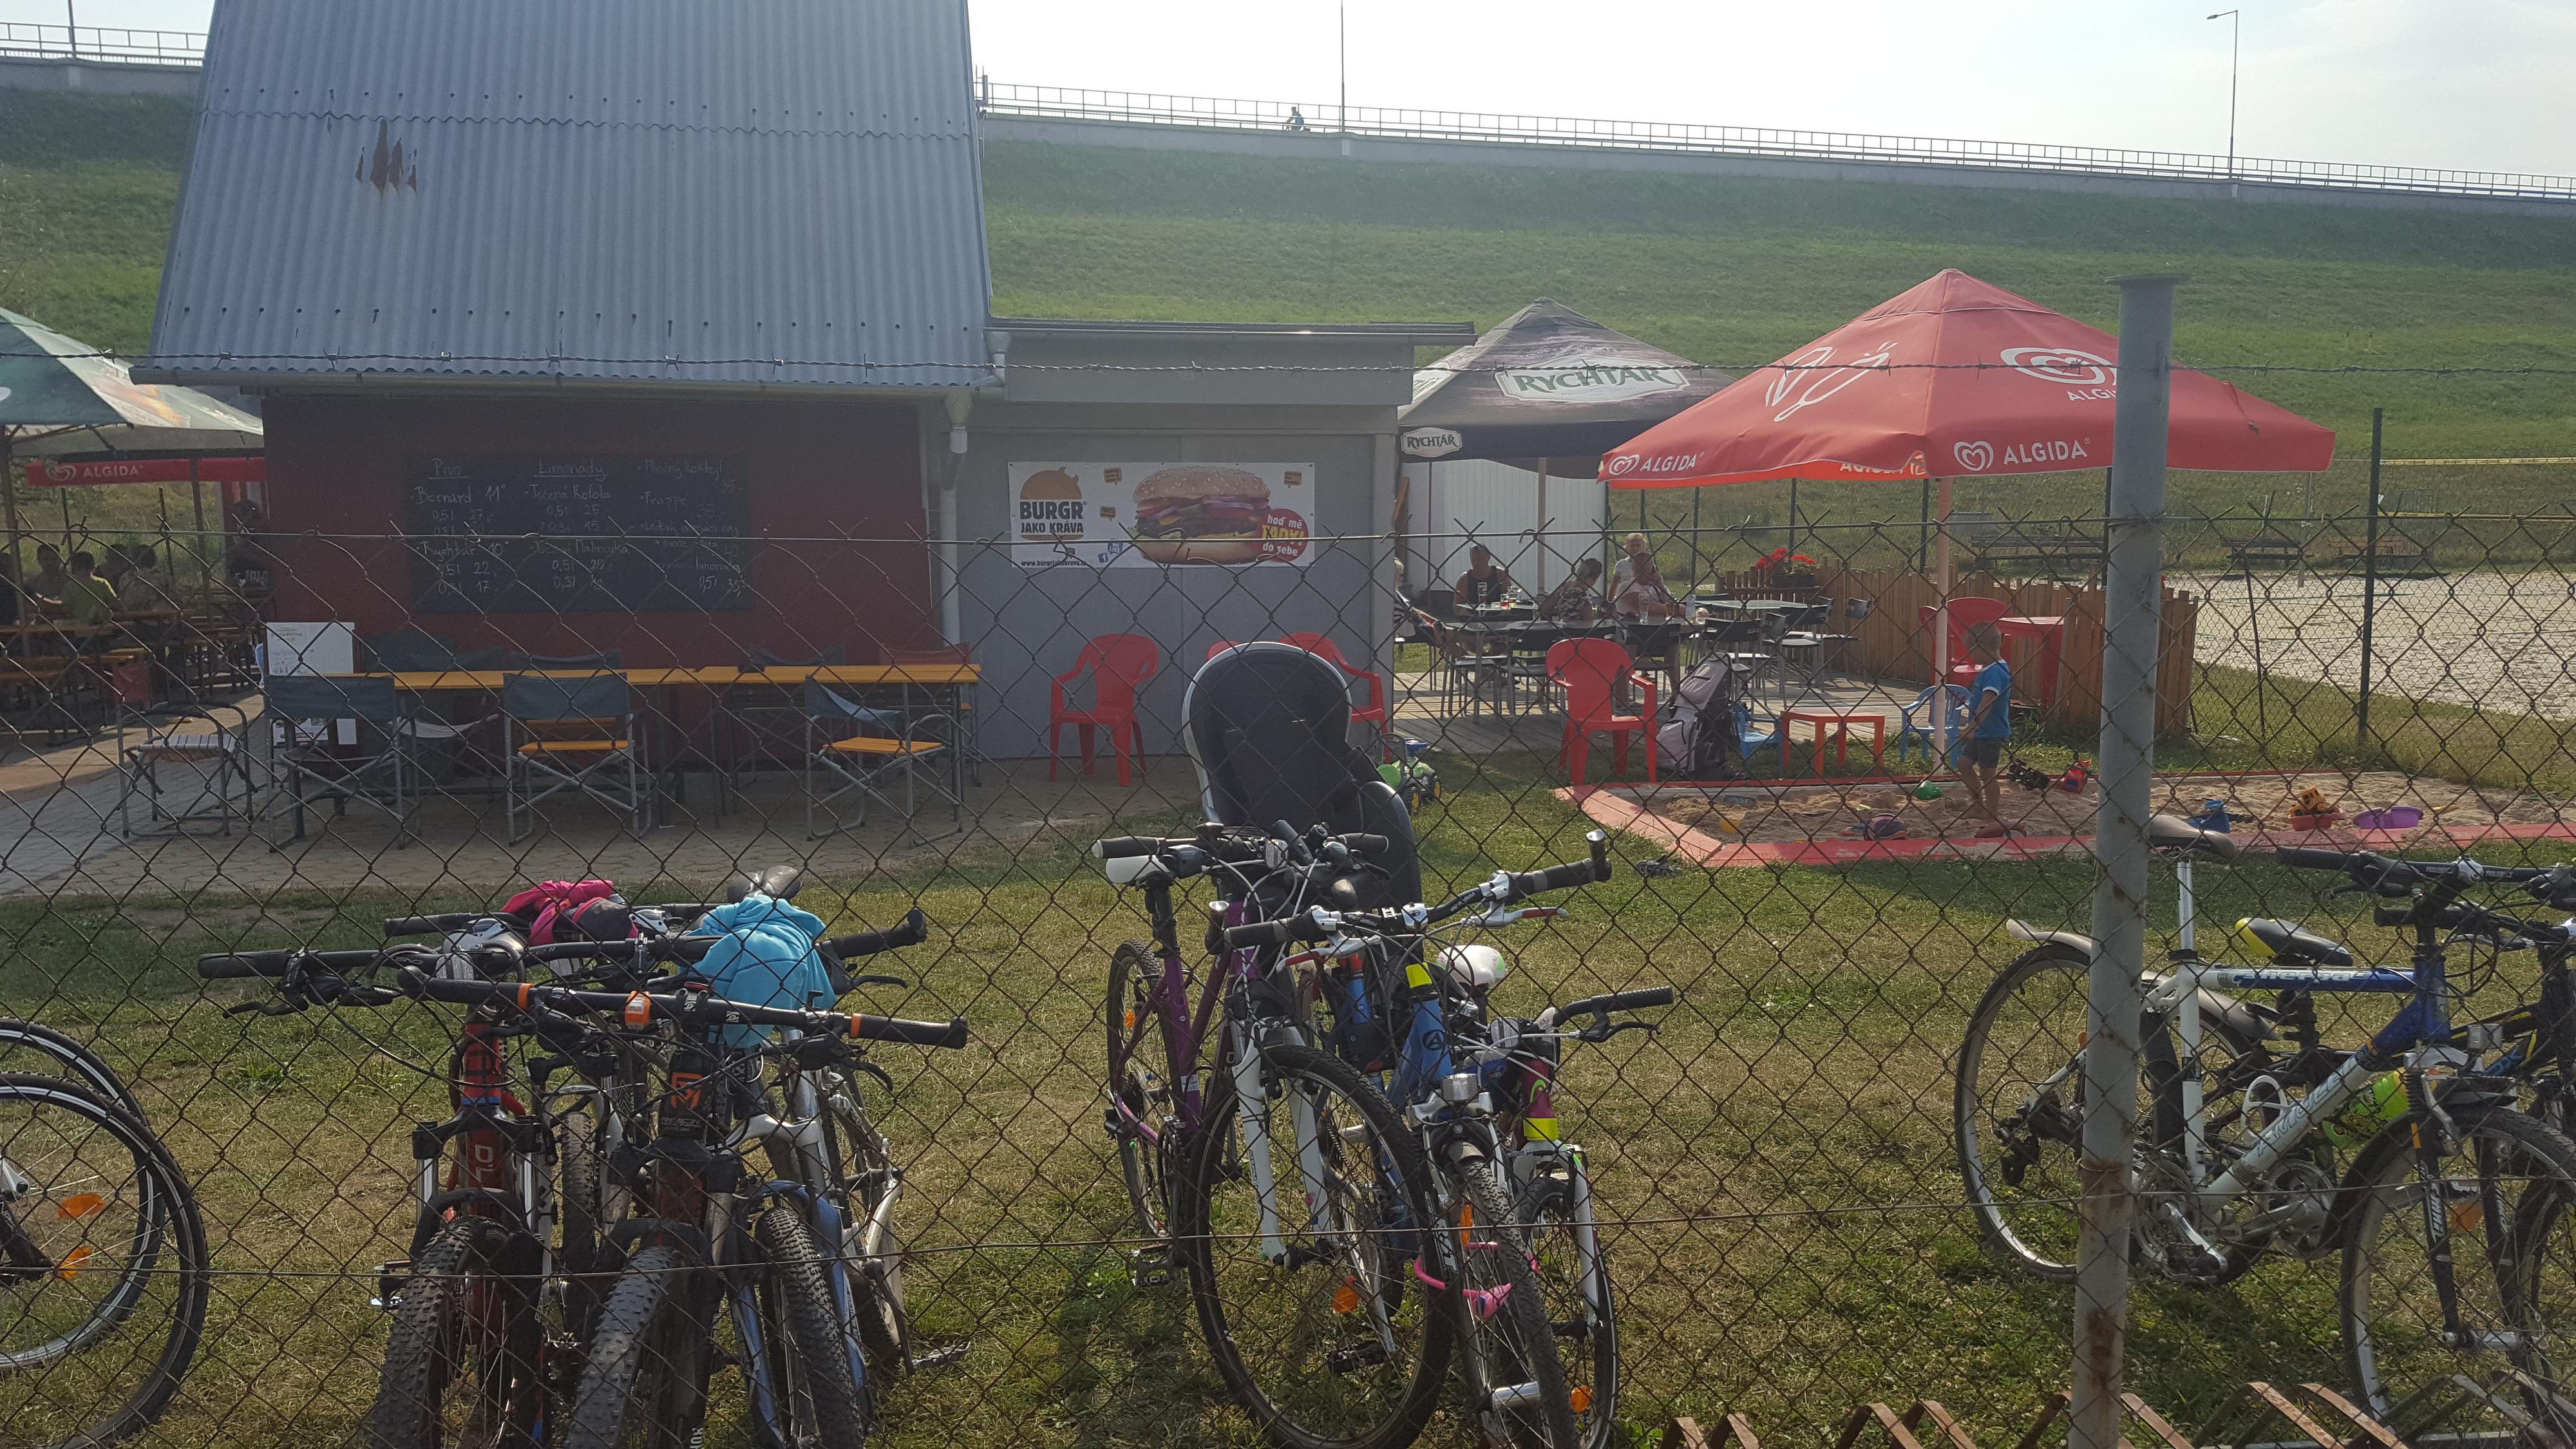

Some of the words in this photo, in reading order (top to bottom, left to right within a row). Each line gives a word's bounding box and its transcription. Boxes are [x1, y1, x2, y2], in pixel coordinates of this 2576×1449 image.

[2067, 388, 2116, 401] ALGI
[1406, 435, 1459, 450] RYCHTÁŘ
[2003, 439, 2088, 466] ALGIDA
[1640, 453, 1698, 472] ALGIDA
[82, 466, 140, 478] ALGIDA
[414, 486, 471, 505] Bernard
[1019, 501, 1083, 520] BURGR
[1021, 522, 1045, 534] JAKO
[1049, 520, 1084, 534] KRÁVA
[1267, 514, 1287, 526] hoď
[1288, 519, 1303, 529] mě
[1262, 542, 1274, 552] do
[1276, 545, 1298, 557] sebe
